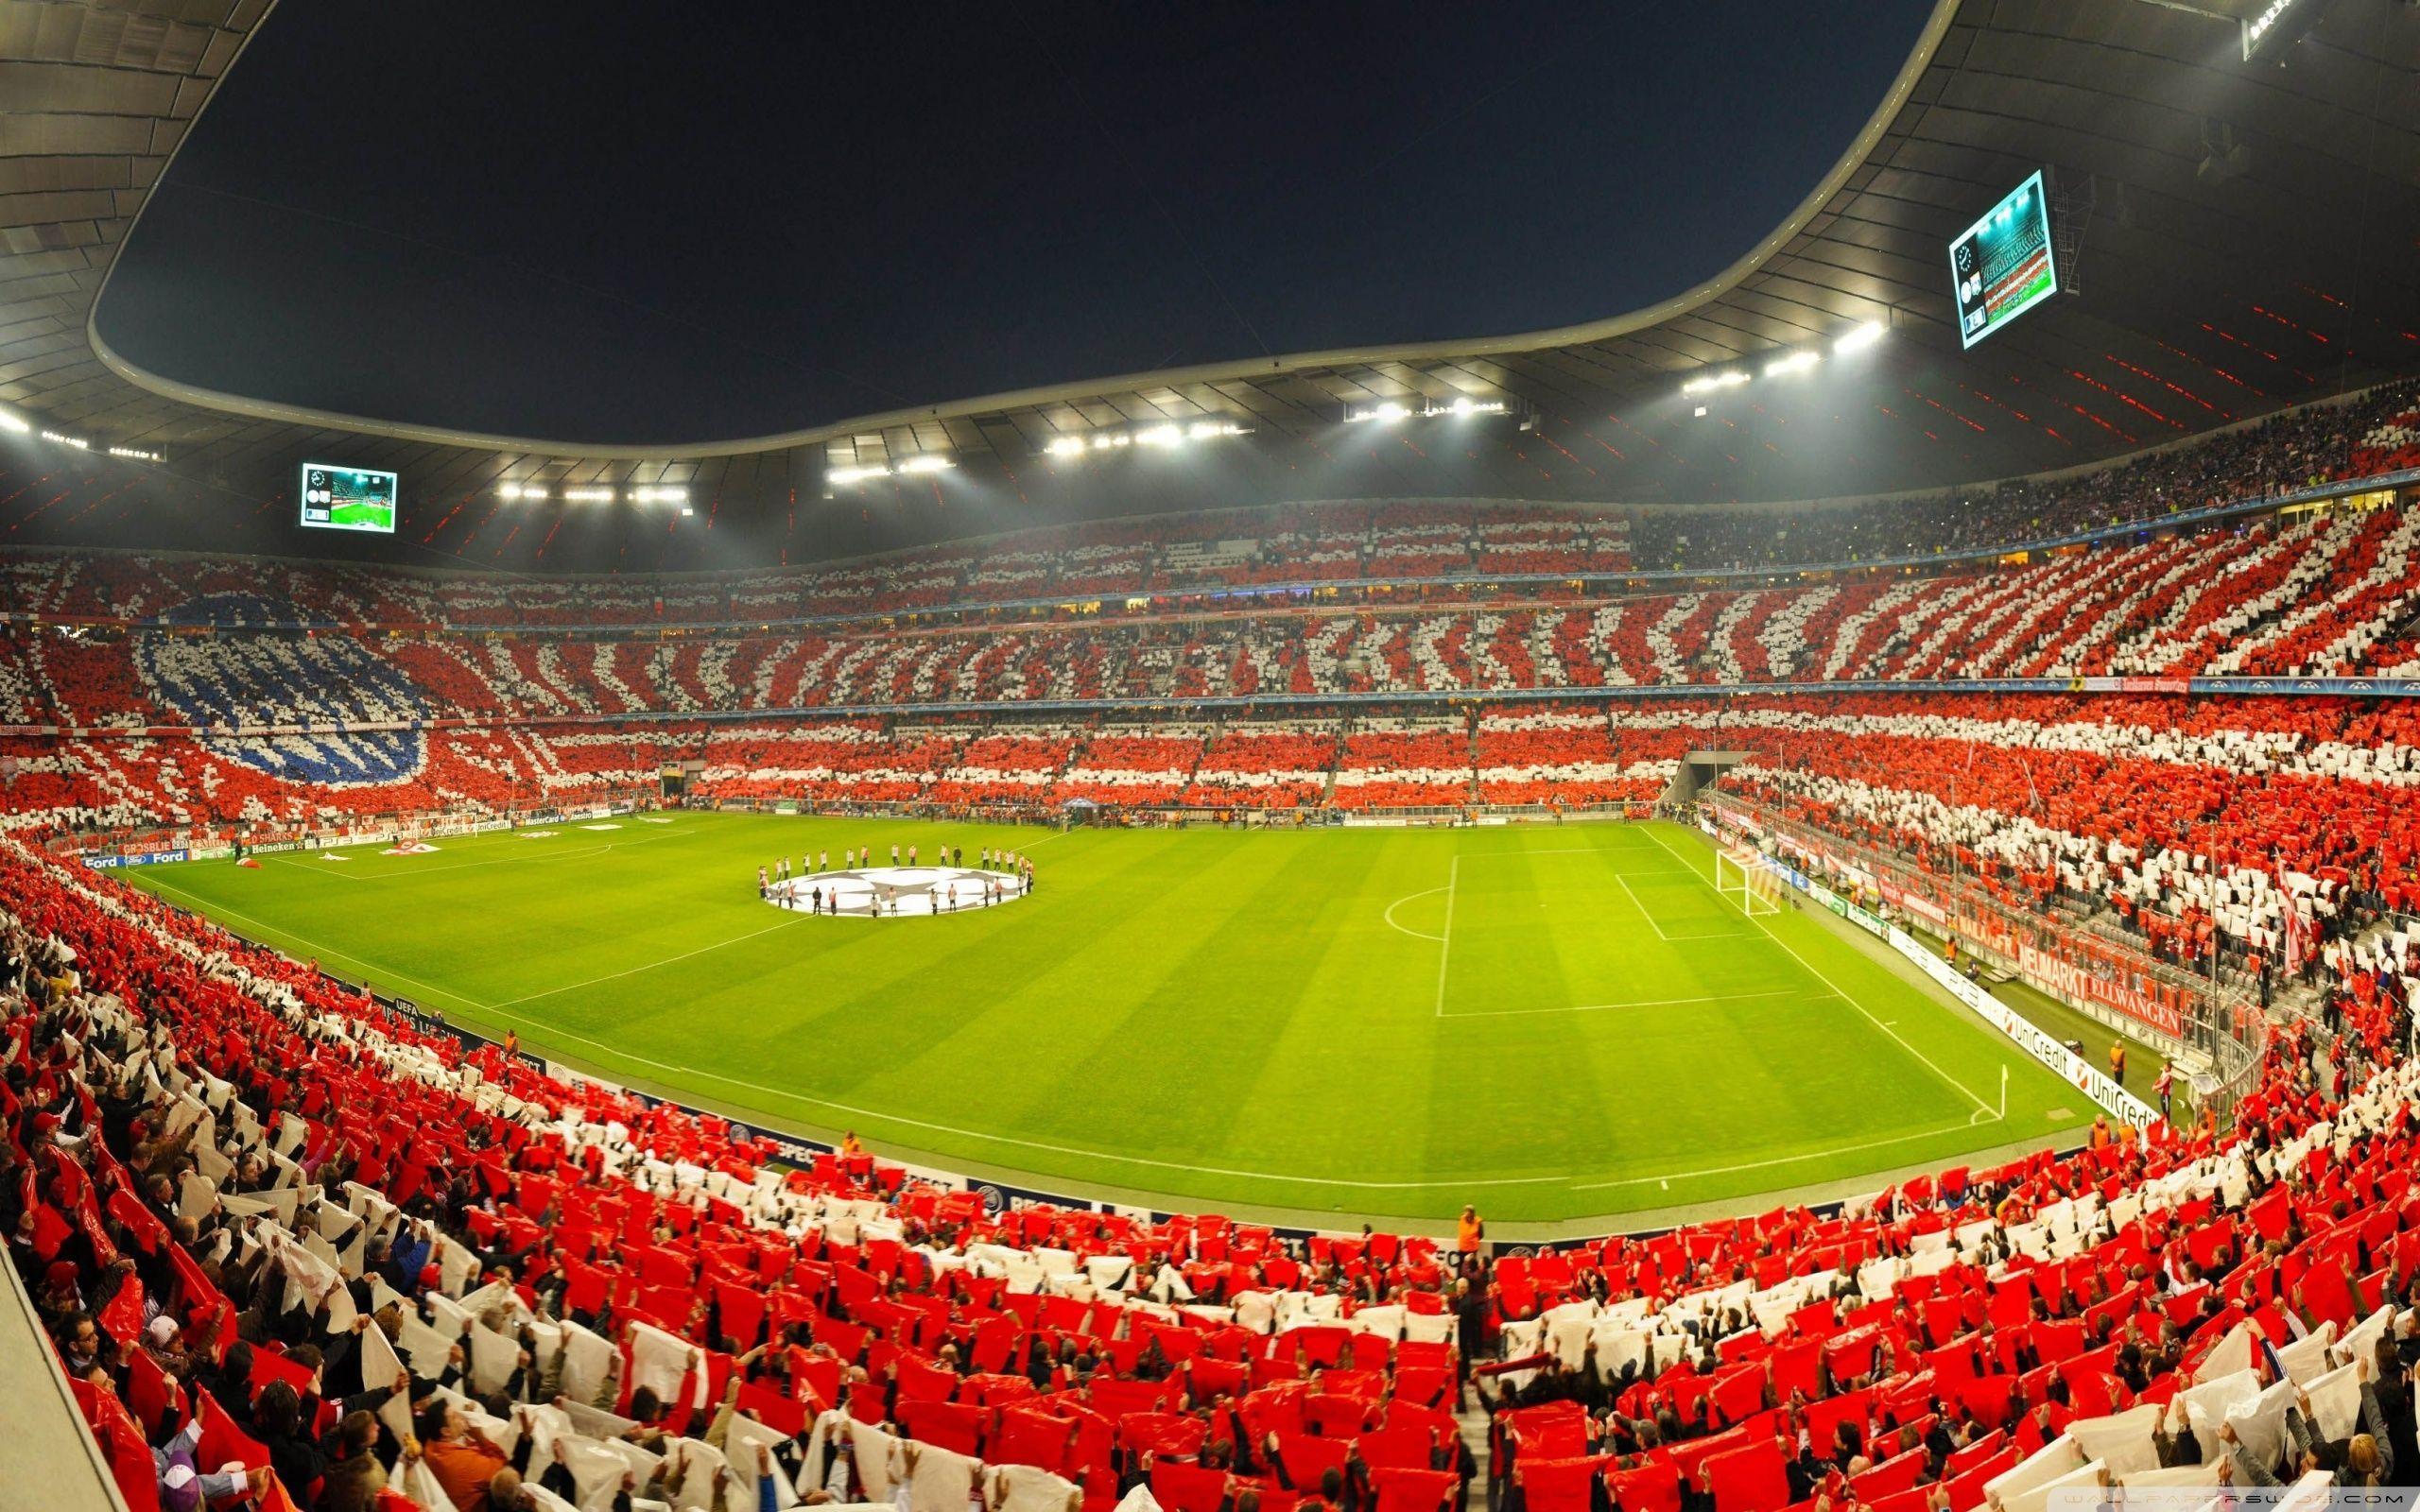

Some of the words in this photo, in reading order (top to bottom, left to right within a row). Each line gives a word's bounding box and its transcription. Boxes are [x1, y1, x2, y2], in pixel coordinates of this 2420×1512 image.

[525, 816, 559, 826] MasterCard
[432, 826, 463, 836] niCredit
[260, 833, 293, 843] SHARKS
[251, 842, 295, 854] Heineken
[85, 857, 117, 868] Ford
[153, 852, 184, 863] Ford
[2019, 943, 2087, 1001] NEUMARKT
[396, 1000, 418, 1017] UEFA
[2092, 978, 2181, 1034] ELLWANGEN
[2015, 1019, 2067, 1075] UniCredit
[2092, 1073, 2159, 1129] UniCredi
